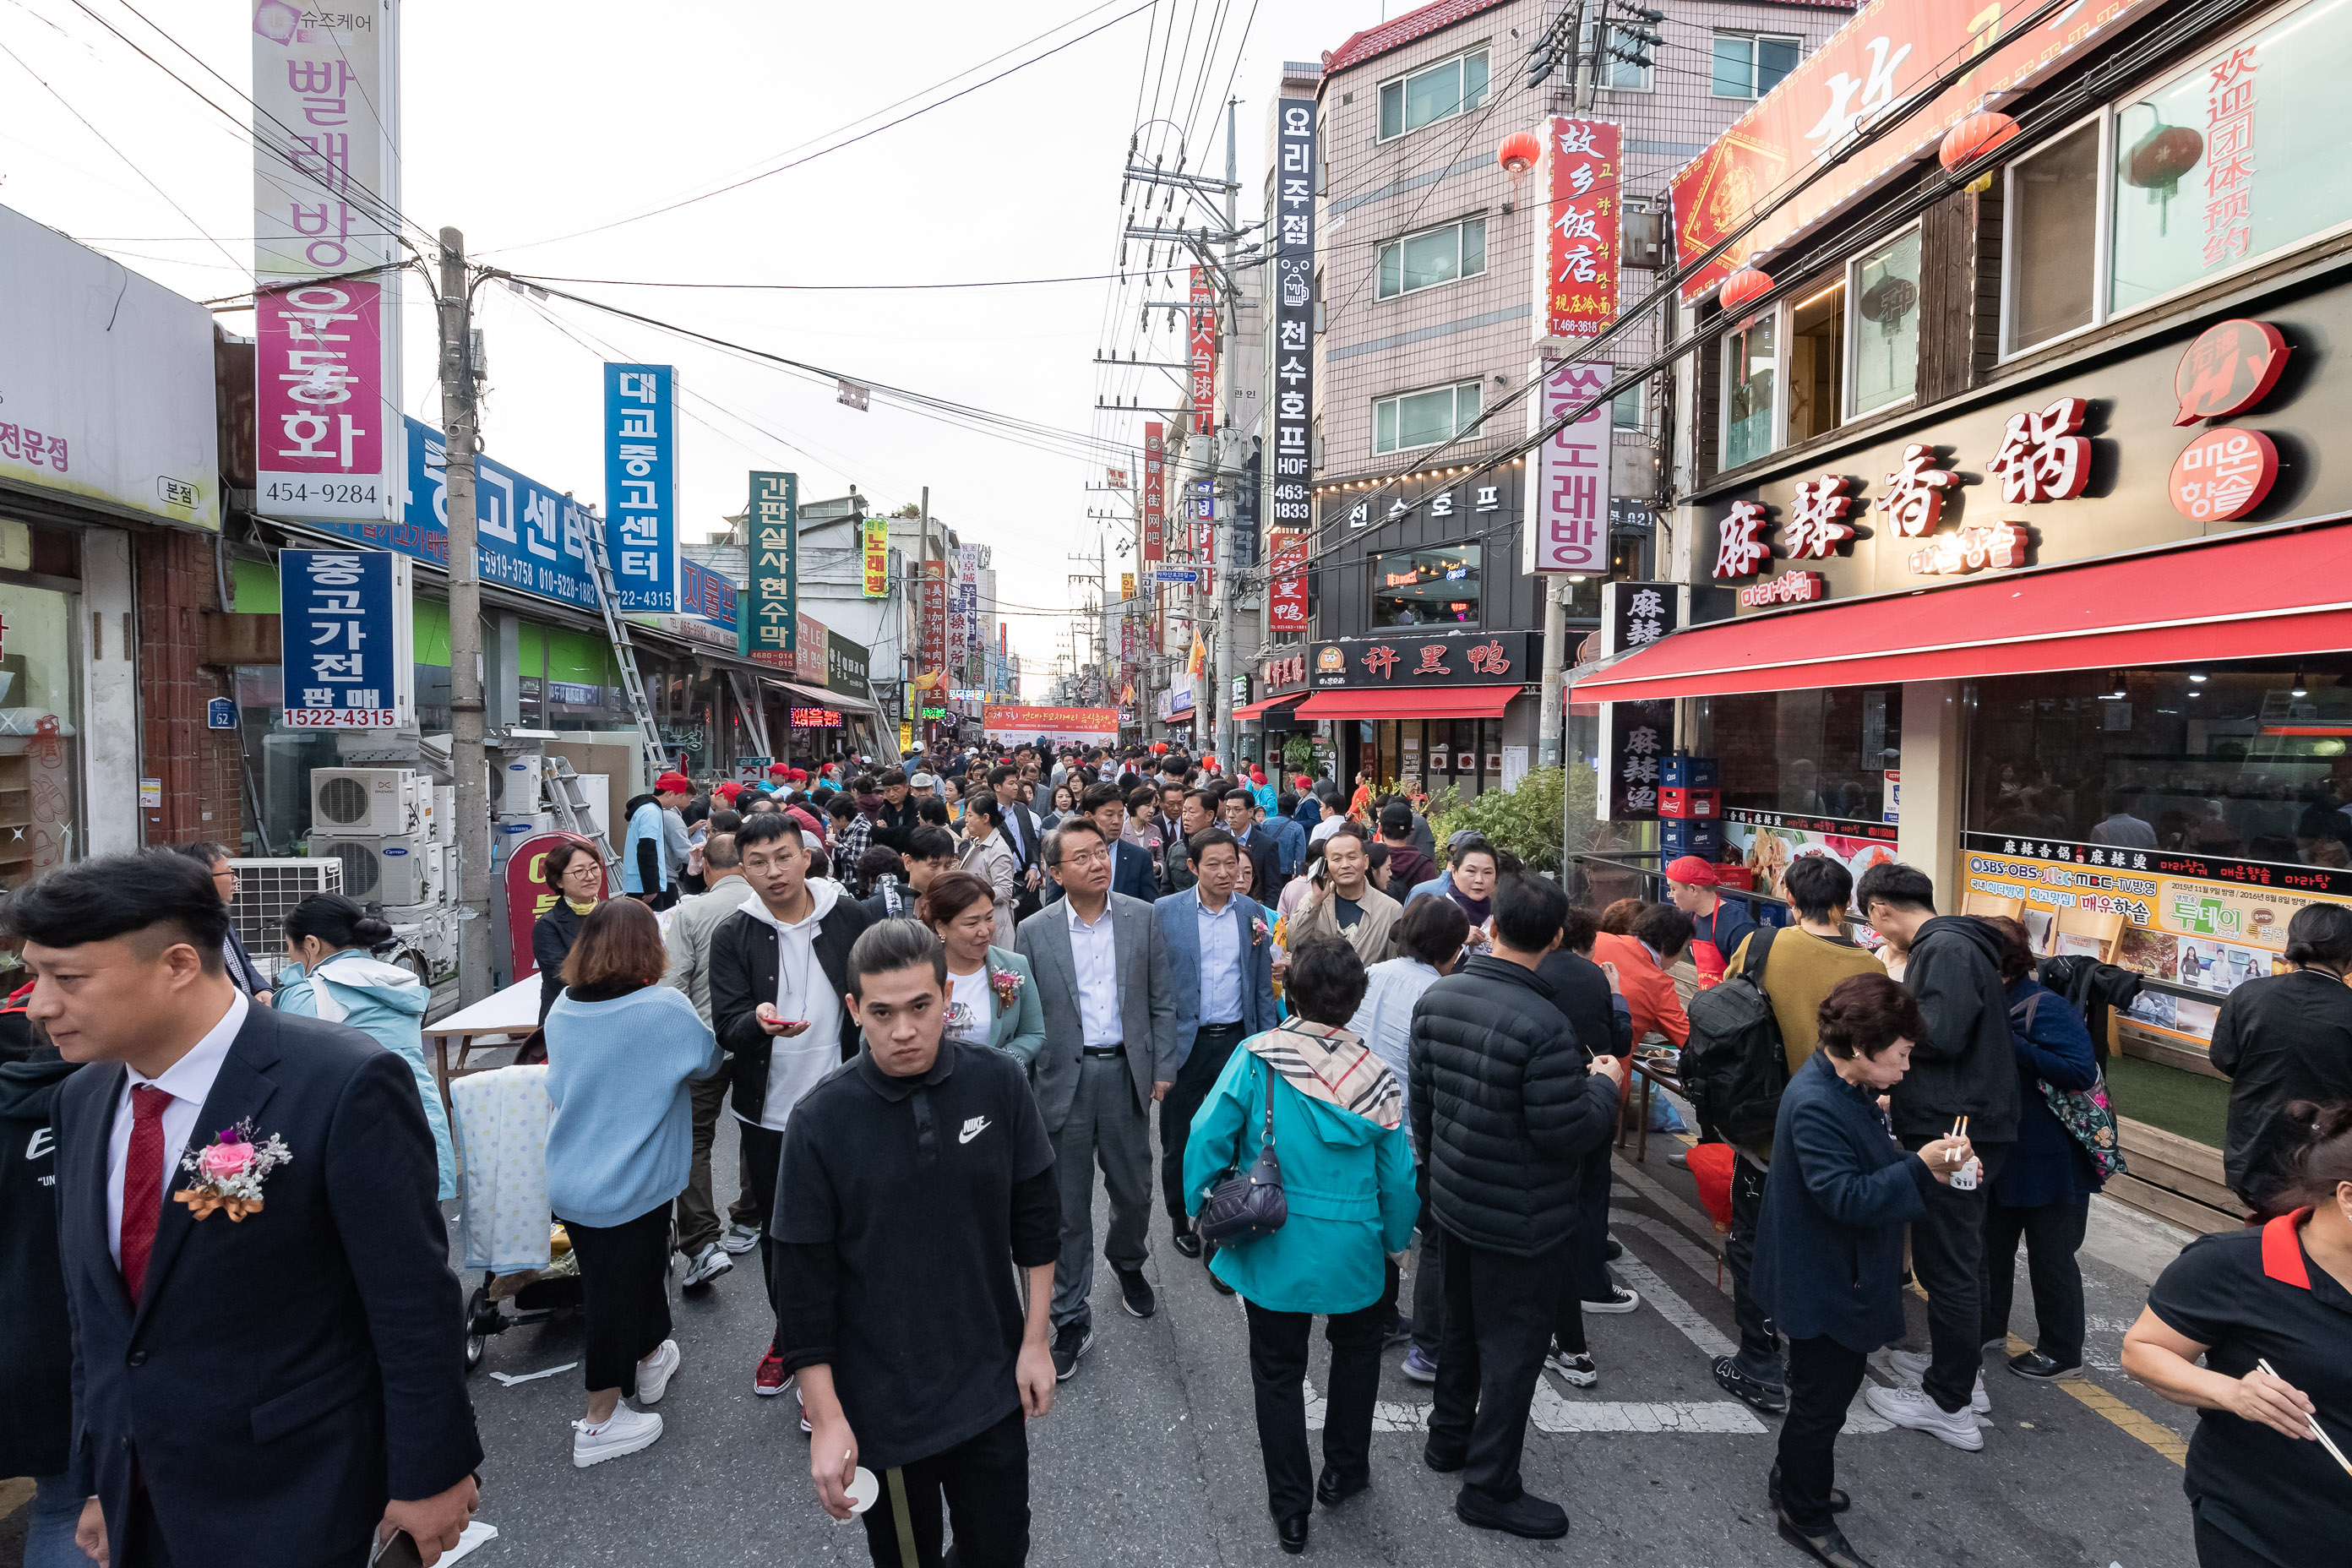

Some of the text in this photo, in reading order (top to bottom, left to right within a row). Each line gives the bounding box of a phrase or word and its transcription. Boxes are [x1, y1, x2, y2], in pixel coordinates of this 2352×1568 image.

[301, 11, 371, 32] 슈즈케어
[286, 59, 357, 268] 빨래방
[2202, 45, 2257, 267] 欢迎团体预约
[1282, 107, 1310, 245] 요리주점
[1554, 124, 1605, 283] 故乡饭店
[1596, 162, 1614, 290] 고향식당
[278, 286, 365, 468] 운동화
[1279, 319, 1307, 455] 천수호프
[618, 372, 658, 582] 대교중고센터
[1277, 458, 1309, 475] HOF
[1549, 369, 1604, 564] 쏭노래방
[166, 482, 192, 504] 본점
[266, 482, 377, 505] 454-9284
[1146, 460, 1161, 545] 唐人街网吧
[1275, 484, 1310, 500] 463-
[1712, 396, 2088, 579] 麻辣香锅
[2180, 475, 2253, 518] 향솥
[1275, 502, 1309, 520] 1833
[758, 476, 790, 649] 간판실사현수막
[867, 533, 886, 593] 노래방
[684, 564, 737, 623] 지물포
[307, 554, 367, 682] 중고가전
[679, 620, 707, 639] 465-9982
[751, 651, 793, 660] 4680-014
[811, 628, 826, 649] LED
[302, 688, 379, 708] 판매
[216, 713, 229, 725] 62
[284, 710, 395, 726] 1522-4315
[1005, 710, 1019, 721] 5회
[1081, 712, 1109, 725] 음식축제
[2003, 840, 2071, 860] 麻辣香锅
[2090, 849, 2148, 870] 麻辣烫
[2220, 865, 2272, 885] 매운향솥
[2284, 874, 2331, 890] 마라탕
[1970, 879, 2151, 926] 국내 최다방영 최고맛집! 매운향솥
[2171, 882, 2193, 893] 2015년
[2194, 885, 2208, 894] 11월
[2209, 887, 2220, 896] 9일
[2221, 888, 2235, 898] 방영
[2240, 890, 2264, 901] 2016년
[2265, 893, 2277, 903] 8월
[2278, 896, 2290, 904] 8일
[2291, 897, 2306, 906] 방영
[2175, 894, 2196, 904] 생방송
[2170, 899, 2241, 934] 투데이
[2217, 929, 2240, 939] Today
[2247, 923, 2288, 943] 특별한
[963, 1115, 985, 1134] NIKE
